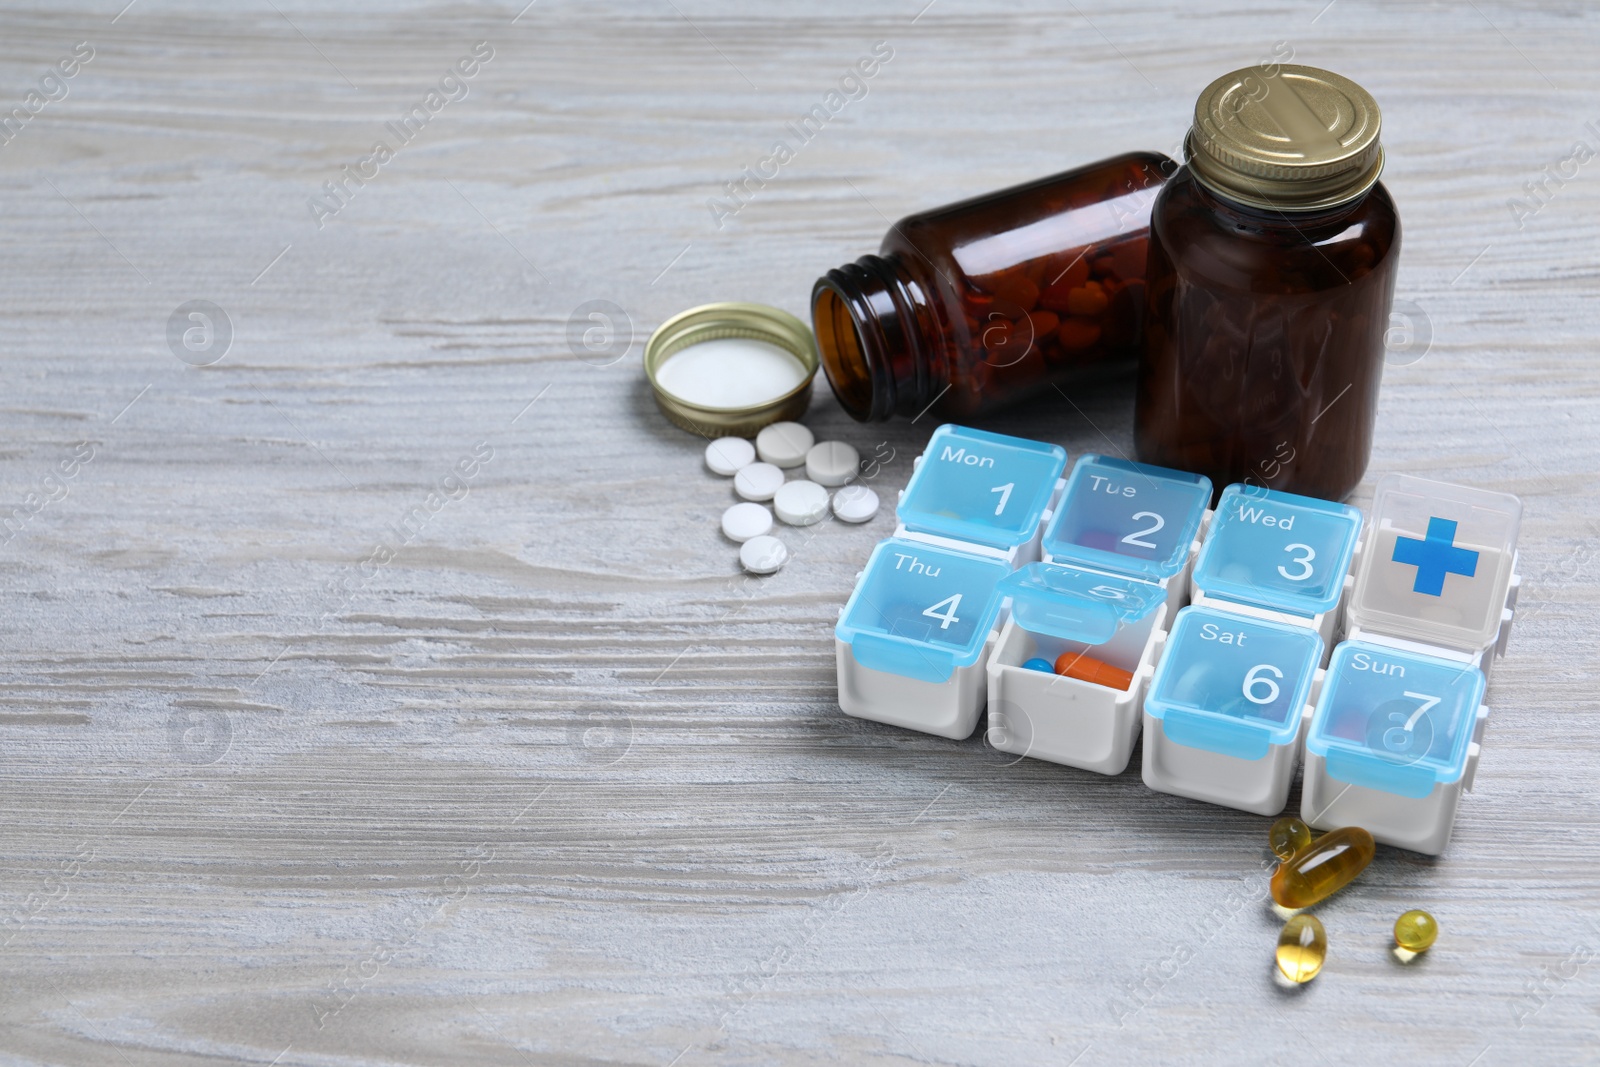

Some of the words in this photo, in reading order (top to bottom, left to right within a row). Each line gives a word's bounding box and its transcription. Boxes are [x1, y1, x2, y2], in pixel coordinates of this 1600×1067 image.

[940, 446, 995, 469] Mon
[990, 482, 1015, 516] 1
[1090, 475, 1136, 498] Tue
[1121, 511, 1165, 549] 2
[1238, 505, 1295, 531] Wed
[894, 553, 941, 578] Thu
[1277, 543, 1316, 581] 3
[1087, 585, 1128, 599] 5
[922, 593, 963, 630] 4
[1200, 623, 1247, 647] Sat
[1351, 653, 1405, 678] Sun
[1242, 664, 1284, 704] 6
[1403, 690, 1442, 732] 7
